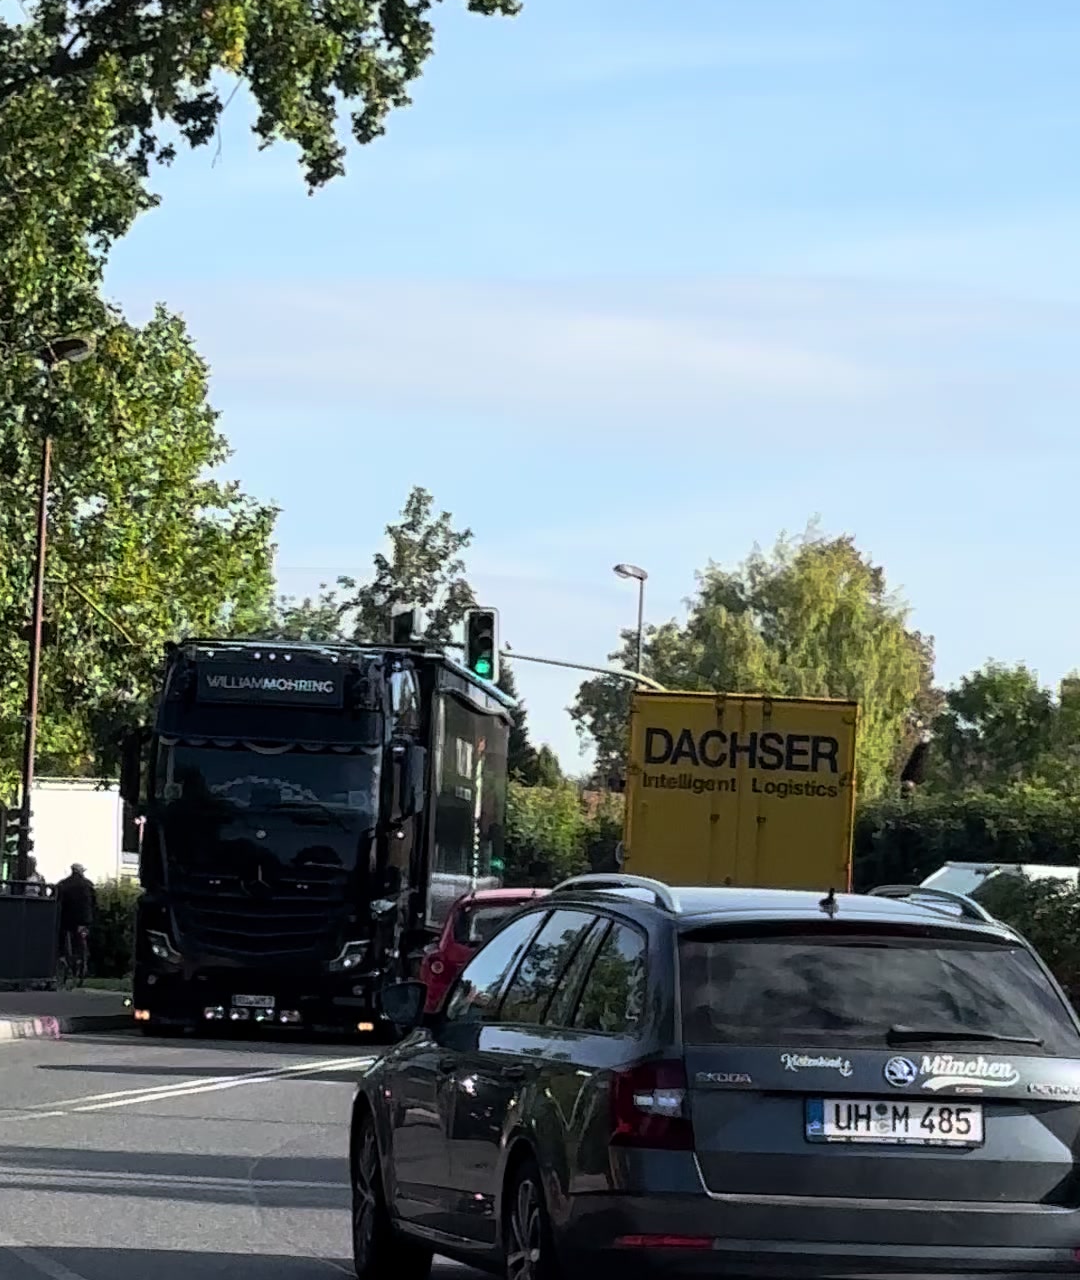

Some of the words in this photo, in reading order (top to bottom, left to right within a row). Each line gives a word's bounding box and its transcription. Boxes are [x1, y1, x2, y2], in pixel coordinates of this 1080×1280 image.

[645, 727, 838, 773] DACHSER
[643, 772, 737, 794] Intelligent
[752, 777, 838, 799] Logistics
[920, 1055, 1014, 1079] München
[835, 1103, 872, 1132] UH
[892, 1105, 909, 1132] M
[920, 1106, 973, 1135] 485
